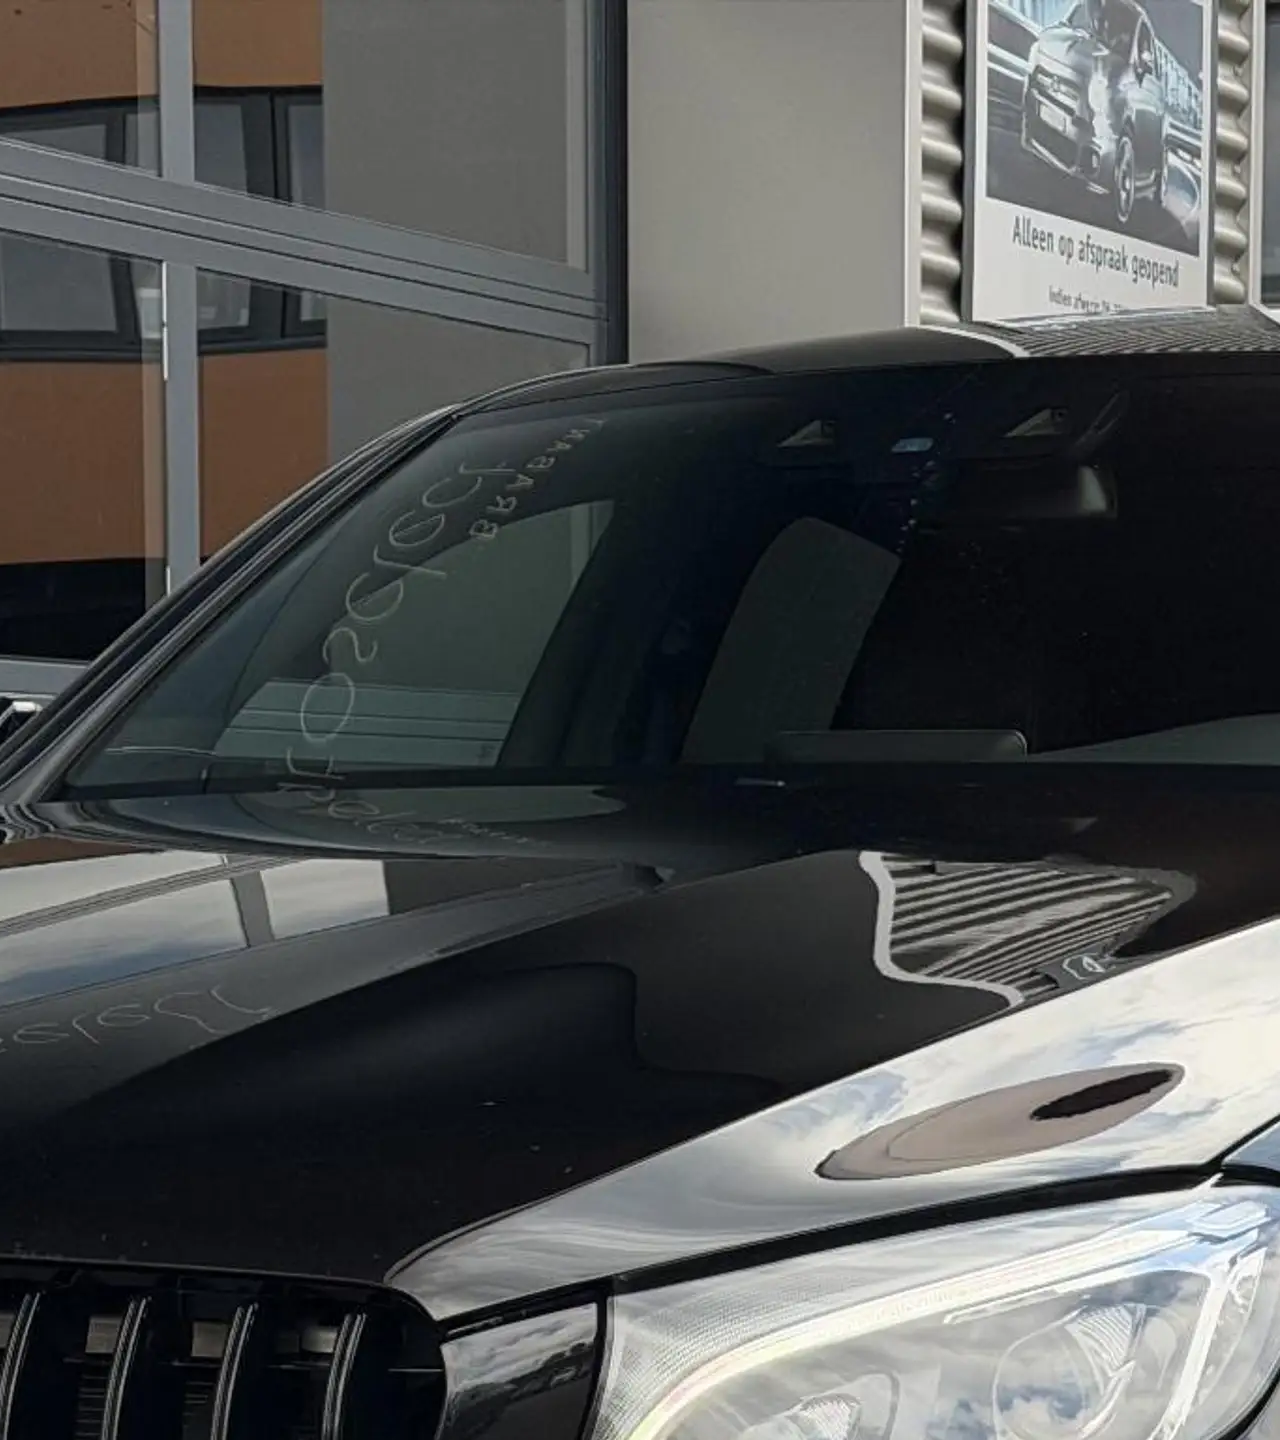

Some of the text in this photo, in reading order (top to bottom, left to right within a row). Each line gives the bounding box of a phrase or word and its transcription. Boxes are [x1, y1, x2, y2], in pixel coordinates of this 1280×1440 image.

[1012, 215, 1055, 253] Alleen
[1058, 234, 1074, 265] op
[1078, 233, 1129, 273] afspraak
